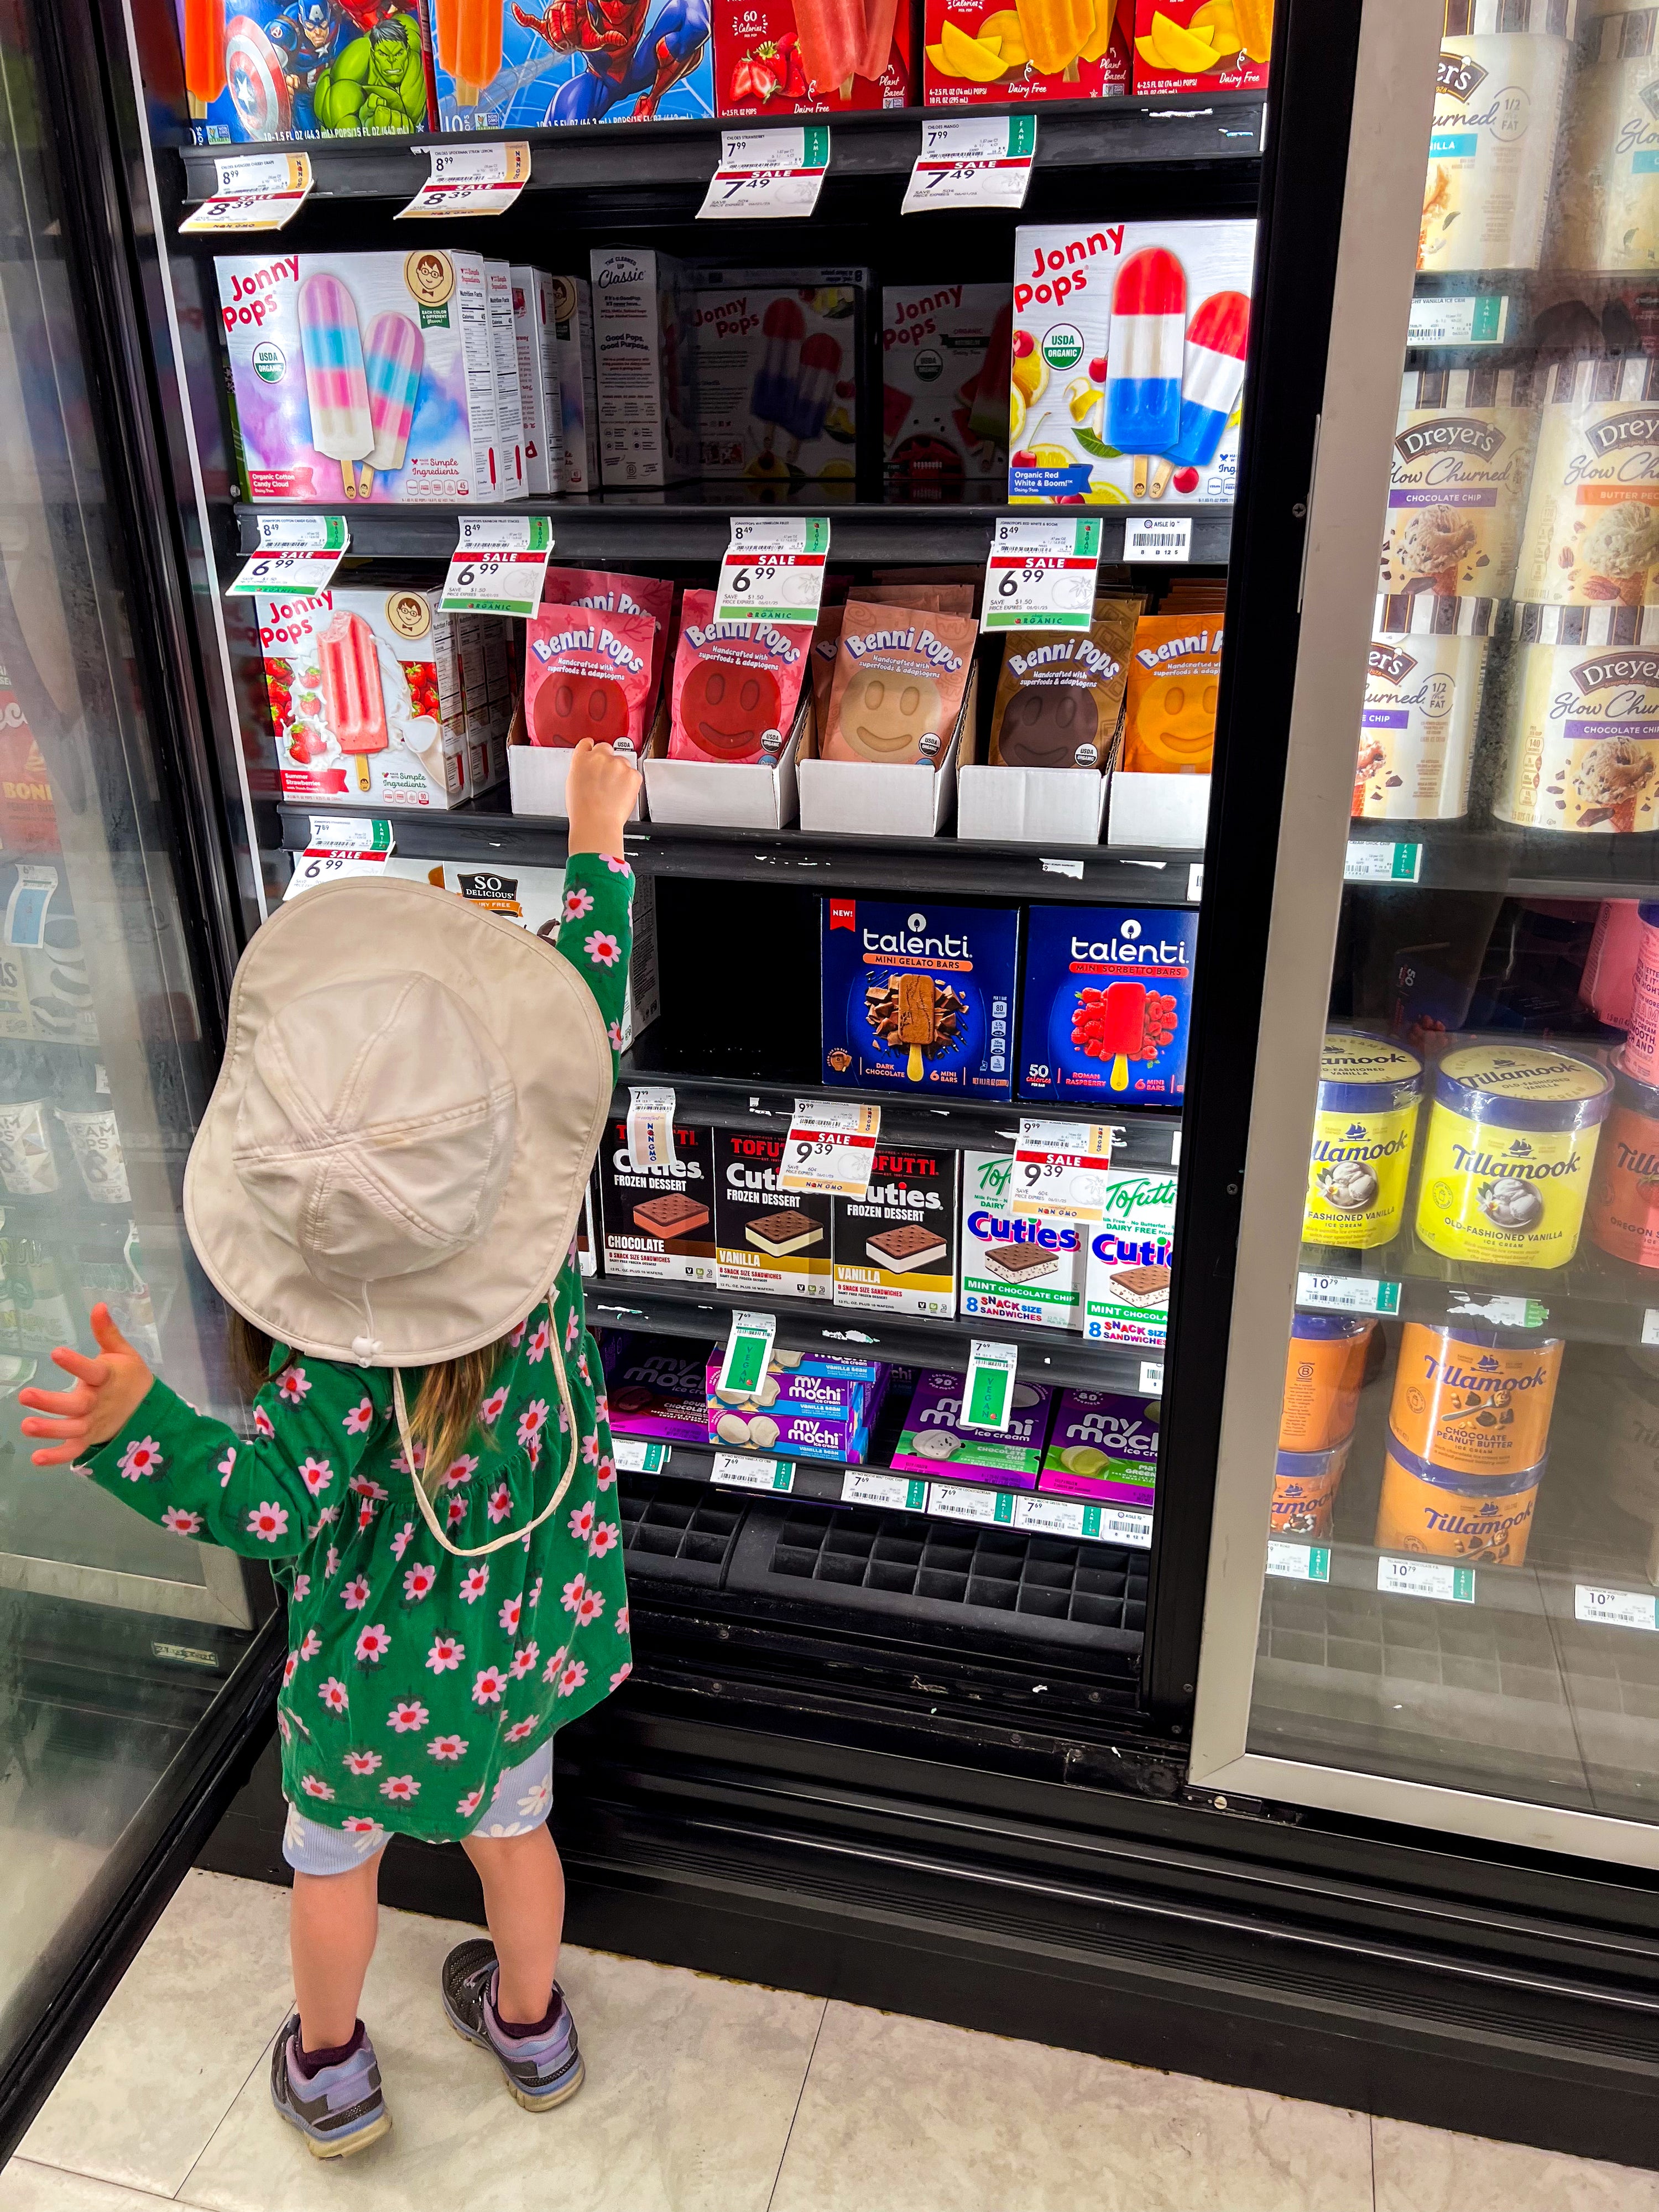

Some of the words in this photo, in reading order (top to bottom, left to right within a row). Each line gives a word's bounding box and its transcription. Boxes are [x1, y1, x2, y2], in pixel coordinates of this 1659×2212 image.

[744, 11, 757, 22] 60
[739, 24, 763, 34] Calories
[1100, 59, 1121, 71] Plant
[1104, 70, 1126, 81] Based
[1008, 83, 1029, 97] Dairy
[1031, 83, 1047, 93] Free
[1505, 98, 1520, 111] 1/2
[1501, 120, 1519, 132] FAT
[286, 131, 294, 140] FL
[295, 131, 302, 140] OZ
[954, 161, 997, 169] SALE
[1032, 225, 1125, 278] Jonny
[231, 255, 299, 301] Jonny
[598, 268, 645, 289] Classic
[1014, 269, 1087, 314] Pops
[222, 292, 278, 332] Pops
[894, 285, 963, 325] Jonny
[885, 318, 937, 351] Pops
[1052, 336, 1075, 346] USDA
[1048, 349, 1077, 358] ORGANIC
[430, 458, 458, 467] Simple
[412, 468, 460, 477] Ingredients
[1015, 472, 1043, 481] Organic
[1425, 457, 1513, 486] Churned
[1564, 455, 1616, 486] Slow
[758, 555, 795, 565] SALE
[1025, 558, 1065, 568] SALE
[532, 627, 594, 663] Benni
[598, 628, 644, 675] Pops
[844, 627, 915, 659] Benni
[914, 629, 963, 672] Pops
[873, 655, 915, 667] Handcrafted
[1009, 639, 1076, 678] Benni
[1074, 639, 1120, 680] Pops
[859, 661, 894, 671] superfoods
[902, 667, 941, 679] adaptogens
[1432, 684, 1447, 692] 1/2
[1430, 700, 1446, 708] FAT
[474, 877, 502, 890] SO
[466, 889, 512, 899] DELICIOUS
[833, 909, 853, 917] NEW!
[863, 928, 969, 958] talenti
[1071, 937, 1186, 964] talenti
[899, 958, 933, 967] GELATO
[937, 960, 959, 969] BARS
[1076, 964, 1098, 972] MINI
[1102, 964, 1154, 975] SORBETTO
[1156, 967, 1182, 976] BARS
[865, 1068, 905, 1078] CHOCOLATE
[930, 1070, 940, 1081] 6
[1029, 1065, 1049, 1077] 50
[1455, 1062, 1578, 1088] Tillamook
[1065, 1078, 1107, 1087] RASPBERRY
[1502, 1078, 1571, 1090] OLD-FASHIONED
[1523, 1082, 1559, 1091] VANILLA
[818, 1133, 851, 1145] SALE
[1046, 1154, 1082, 1166] SALE
[1452, 1144, 1580, 1179] Tillamook
[1105, 1178, 1177, 1217] Tofutti
[847, 1204, 881, 1218] FROZEN
[884, 1208, 925, 1222] DESSERT
[967, 1211, 1080, 1251] Cuties
[1106, 1224, 1133, 1232] DAIRY
[1135, 1226, 1157, 1235] FREE
[1444, 1217, 1525, 1242] OLD-FASHIONED
[1528, 1230, 1563, 1241] VANILLA
[1611, 1218, 1655, 1237] OREGON
[608, 1235, 665, 1251] CHOCOLATE
[641, 1255, 671, 1263] SANDWICHES
[837, 1267, 881, 1284] VANILLA
[968, 1280, 997, 1291] MINT
[998, 1286, 1052, 1300] CHOCOLATE
[1053, 1293, 1075, 1302] CHIP
[967, 1297, 978, 1313] 8
[981, 1296, 1019, 1311] SNACK
[1021, 1305, 1042, 1314] SIZE
[980, 1306, 1042, 1322] SANDWICHES
[1424, 1355, 1547, 1391] Tillamook
[795, 1376, 819, 1390] my
[789, 1385, 841, 1401] mochi
[1083, 1413, 1142, 1437] my
[1437, 1431, 1473, 1447] PEANUT
[1474, 1438, 1512, 1448] BUTTER
[1446, 1427, 1507, 1441] CHOCOLATE
